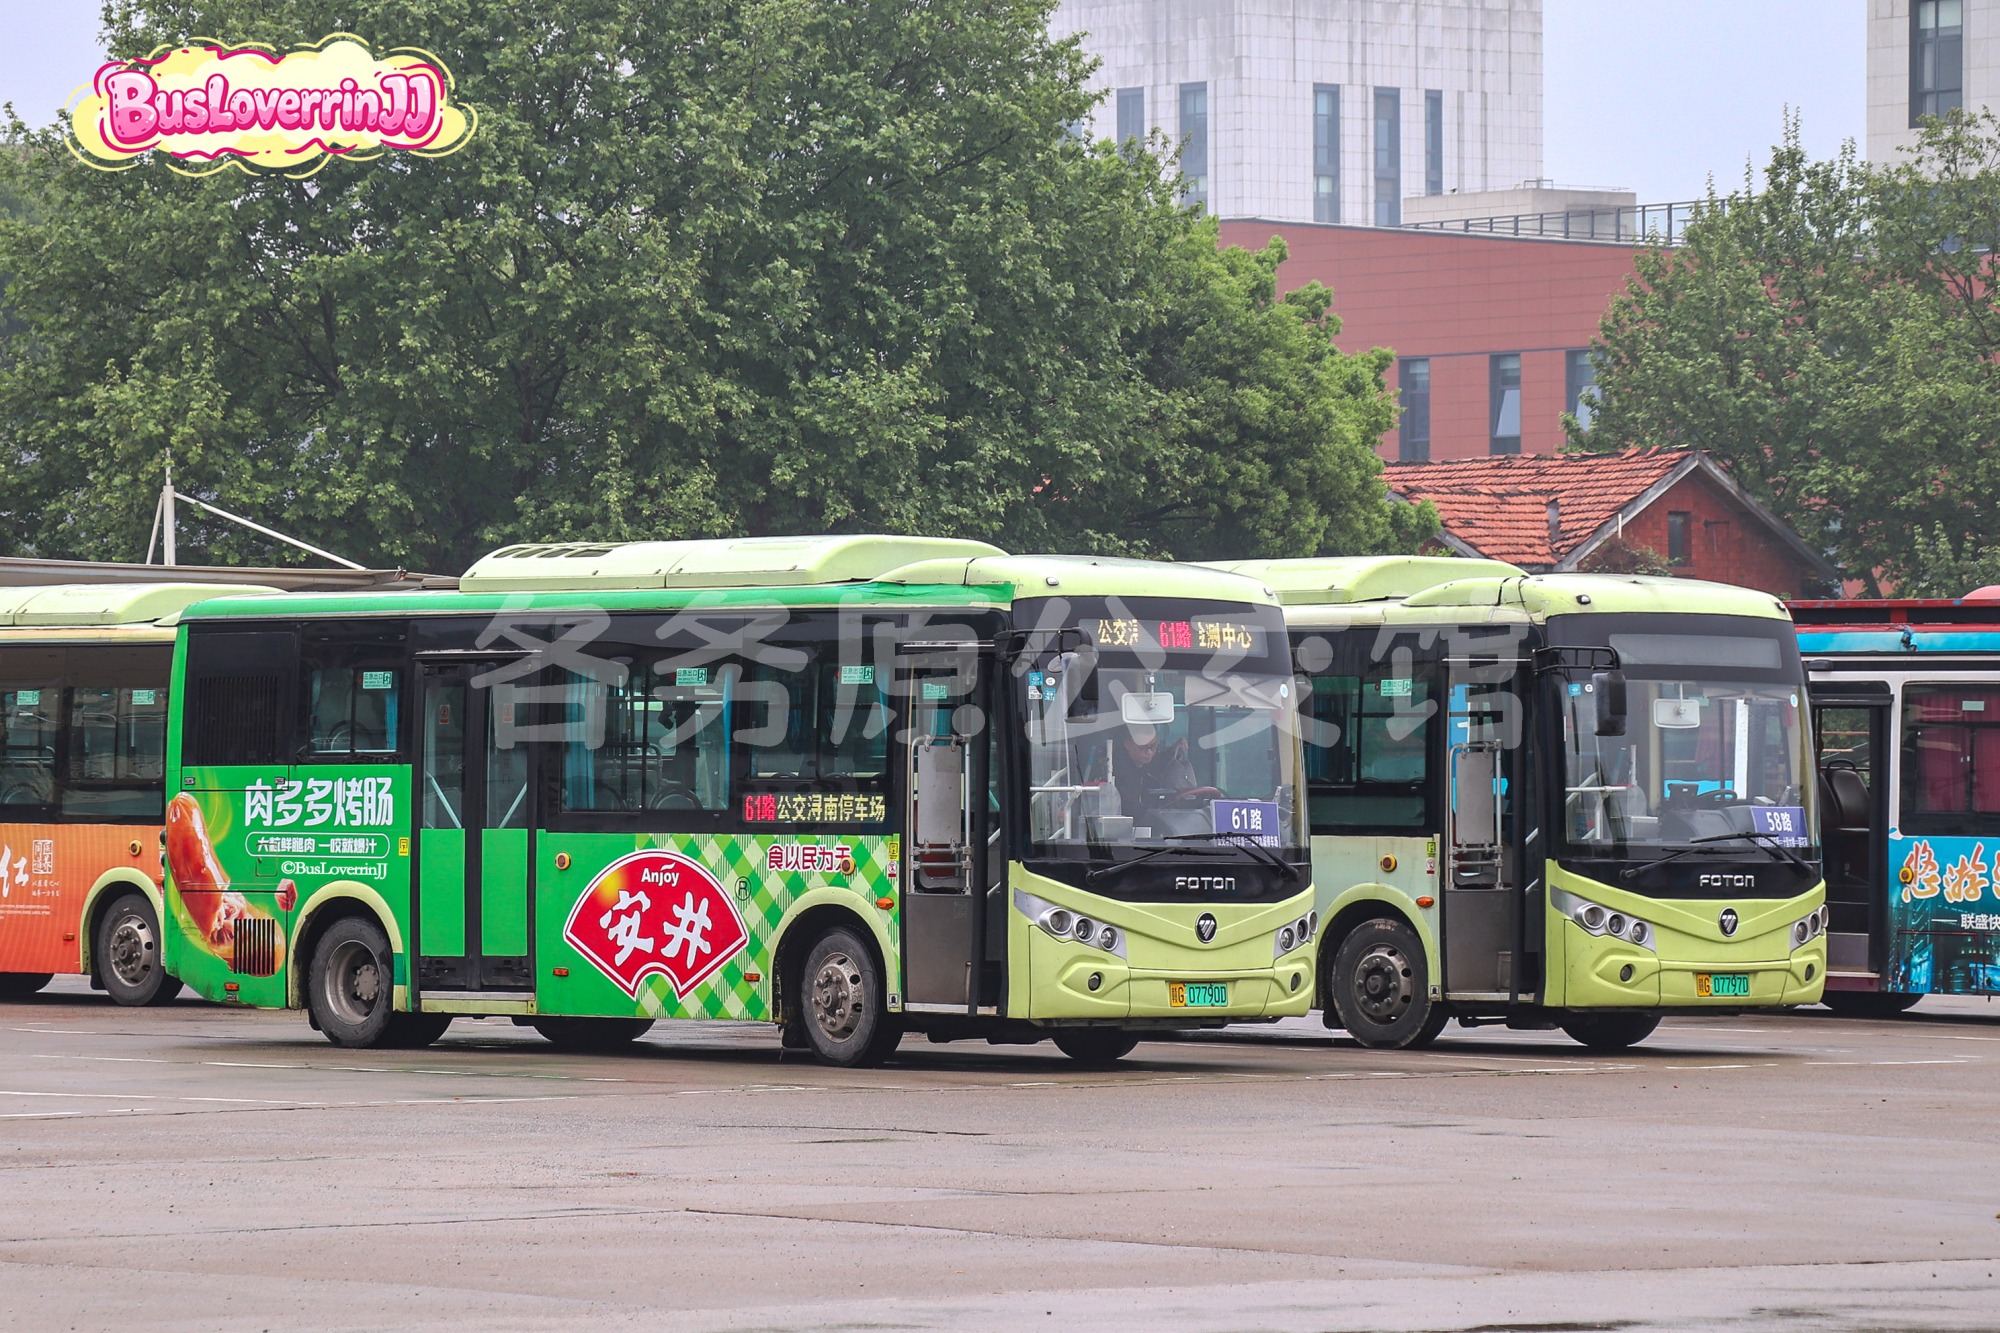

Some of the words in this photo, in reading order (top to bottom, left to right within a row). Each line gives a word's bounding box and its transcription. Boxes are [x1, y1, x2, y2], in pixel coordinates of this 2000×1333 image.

[244, 777, 394, 827] 肉多多烤肠
[777, 793, 886, 822] 公交浔南停车场
[1231, 807, 1263, 831] 61路
[1765, 811, 1793, 832] 58路
[641, 862, 680, 887] Anjoy
[1175, 876, 1236, 891] FOTON
[1699, 874, 1755, 888] FOTON
[1901, 840, 2000, 903] 悠游
[599, 889, 712, 970] 安井
